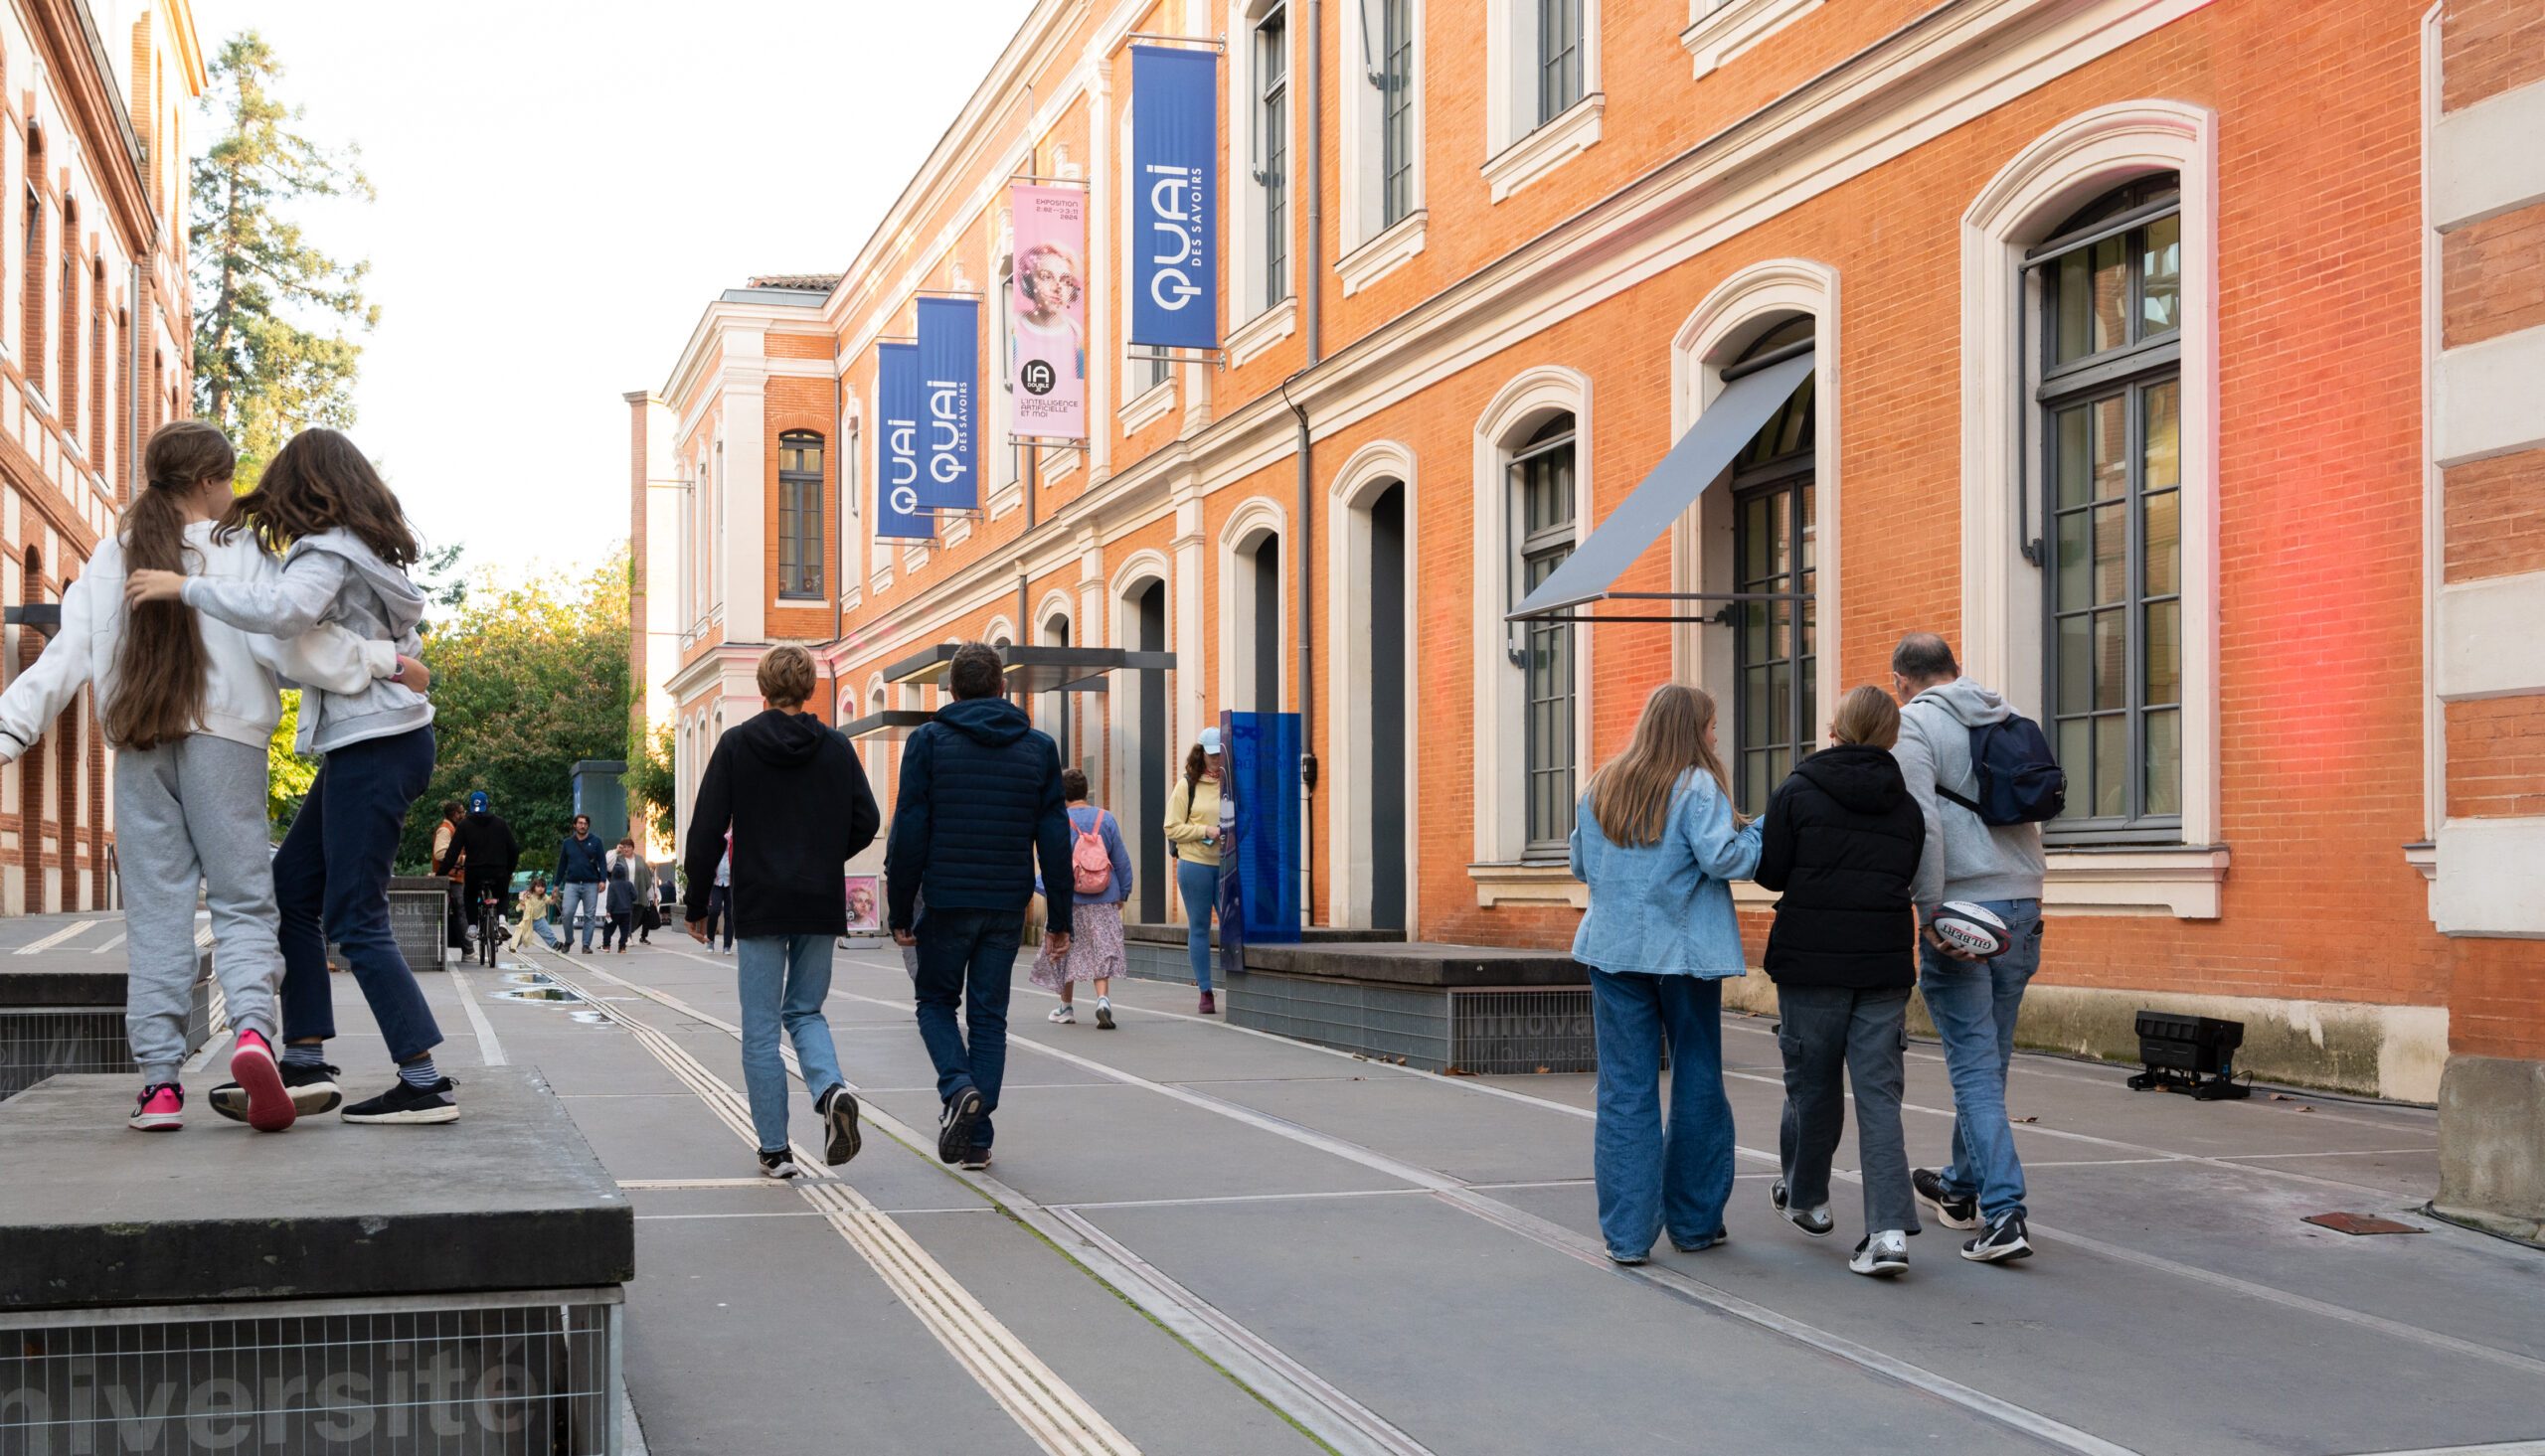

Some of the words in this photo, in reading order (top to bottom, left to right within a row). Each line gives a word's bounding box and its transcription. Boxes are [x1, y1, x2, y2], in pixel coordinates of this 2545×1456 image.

[1036, 199, 1078, 208] EXPOSITION
[1191, 167, 1202, 234] SAVOIRS
[1191, 239, 1202, 267] DES
[1027, 365, 1049, 383] IA
[1941, 923, 1991, 950] GILBERT
